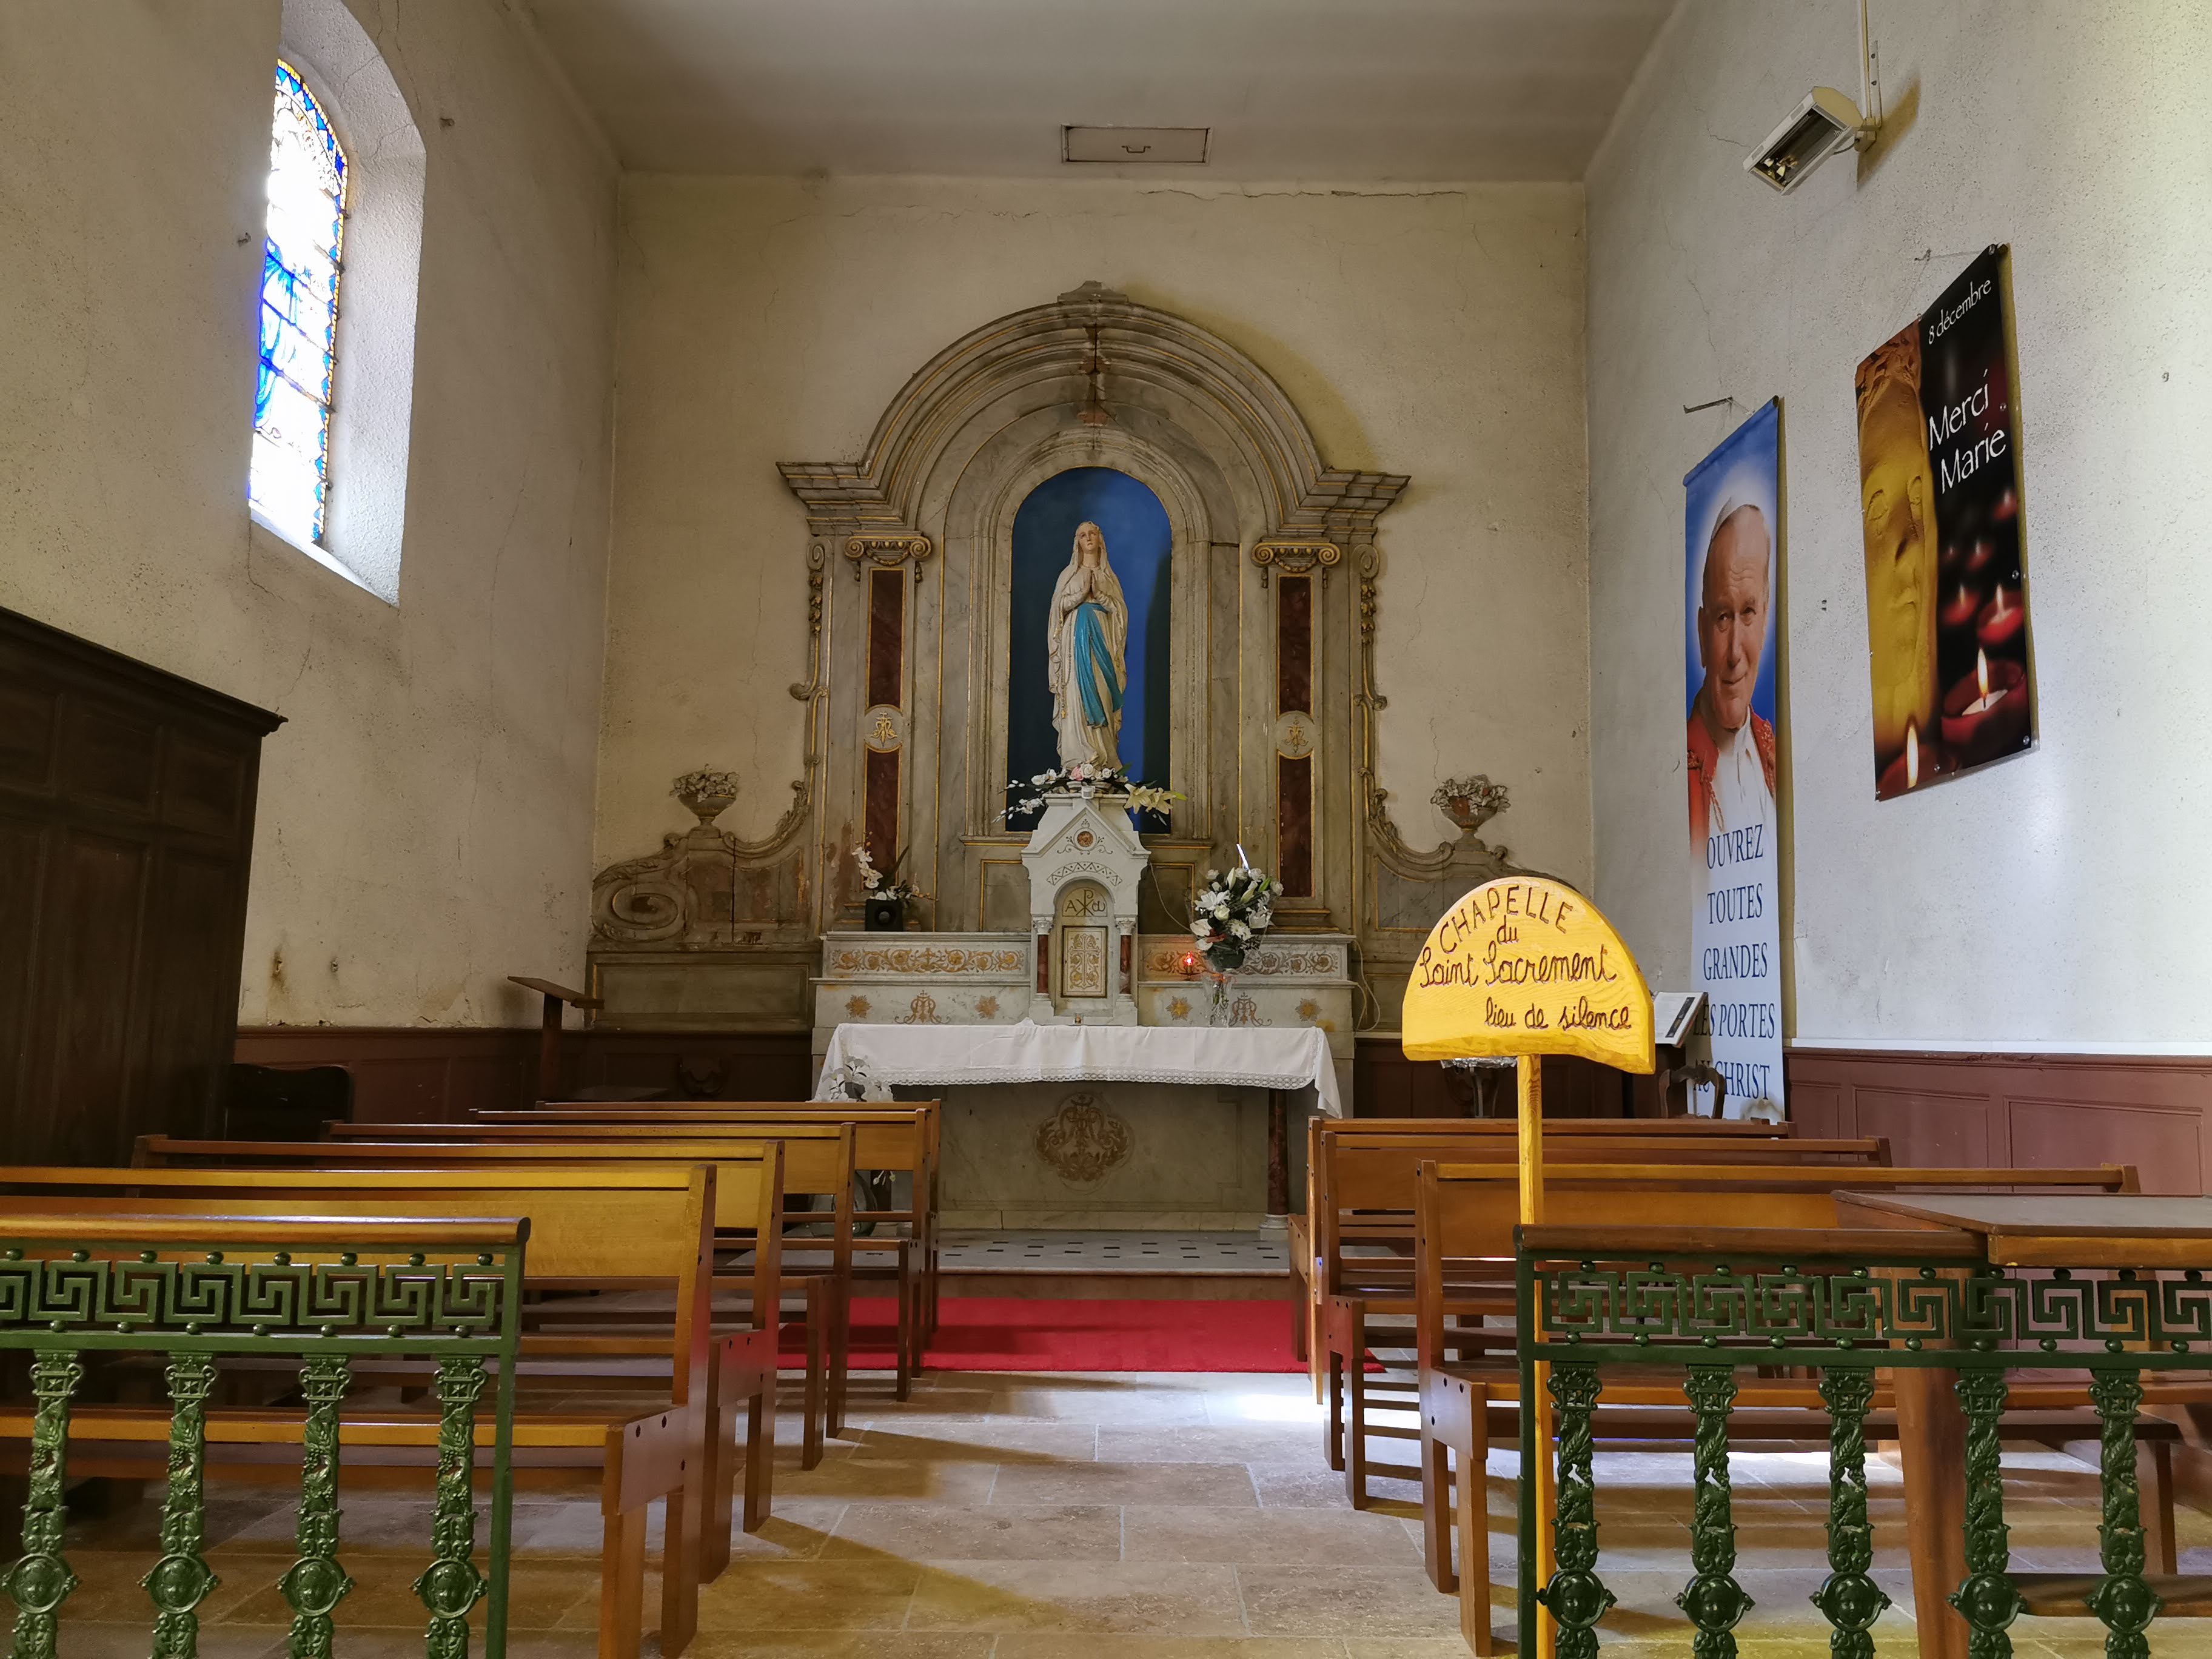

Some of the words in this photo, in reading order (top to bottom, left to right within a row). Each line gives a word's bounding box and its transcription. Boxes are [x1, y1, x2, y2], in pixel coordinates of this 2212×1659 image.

[1928, 324, 1935, 344] 8
[1936, 279, 1992, 337] décembre
[1929, 368, 1989, 451] Merci
[1941, 423, 2006, 494] Marie
[1706, 823, 1763, 870] OUVREZ
[1439, 885, 1574, 954] CHAPELLE
[1707, 883, 1763, 925] TOUTES
[1496, 914, 1520, 944] du
[1419, 947, 1479, 988] Saint
[1483, 940, 1618, 987] Sacrement
[1703, 942, 1768, 980] GRANDES
[1484, 996, 1517, 1026] lieu
[1524, 1003, 1549, 1029] de
[1557, 995, 1632, 1031] silence
[1718, 1003, 1775, 1039] PORTES
